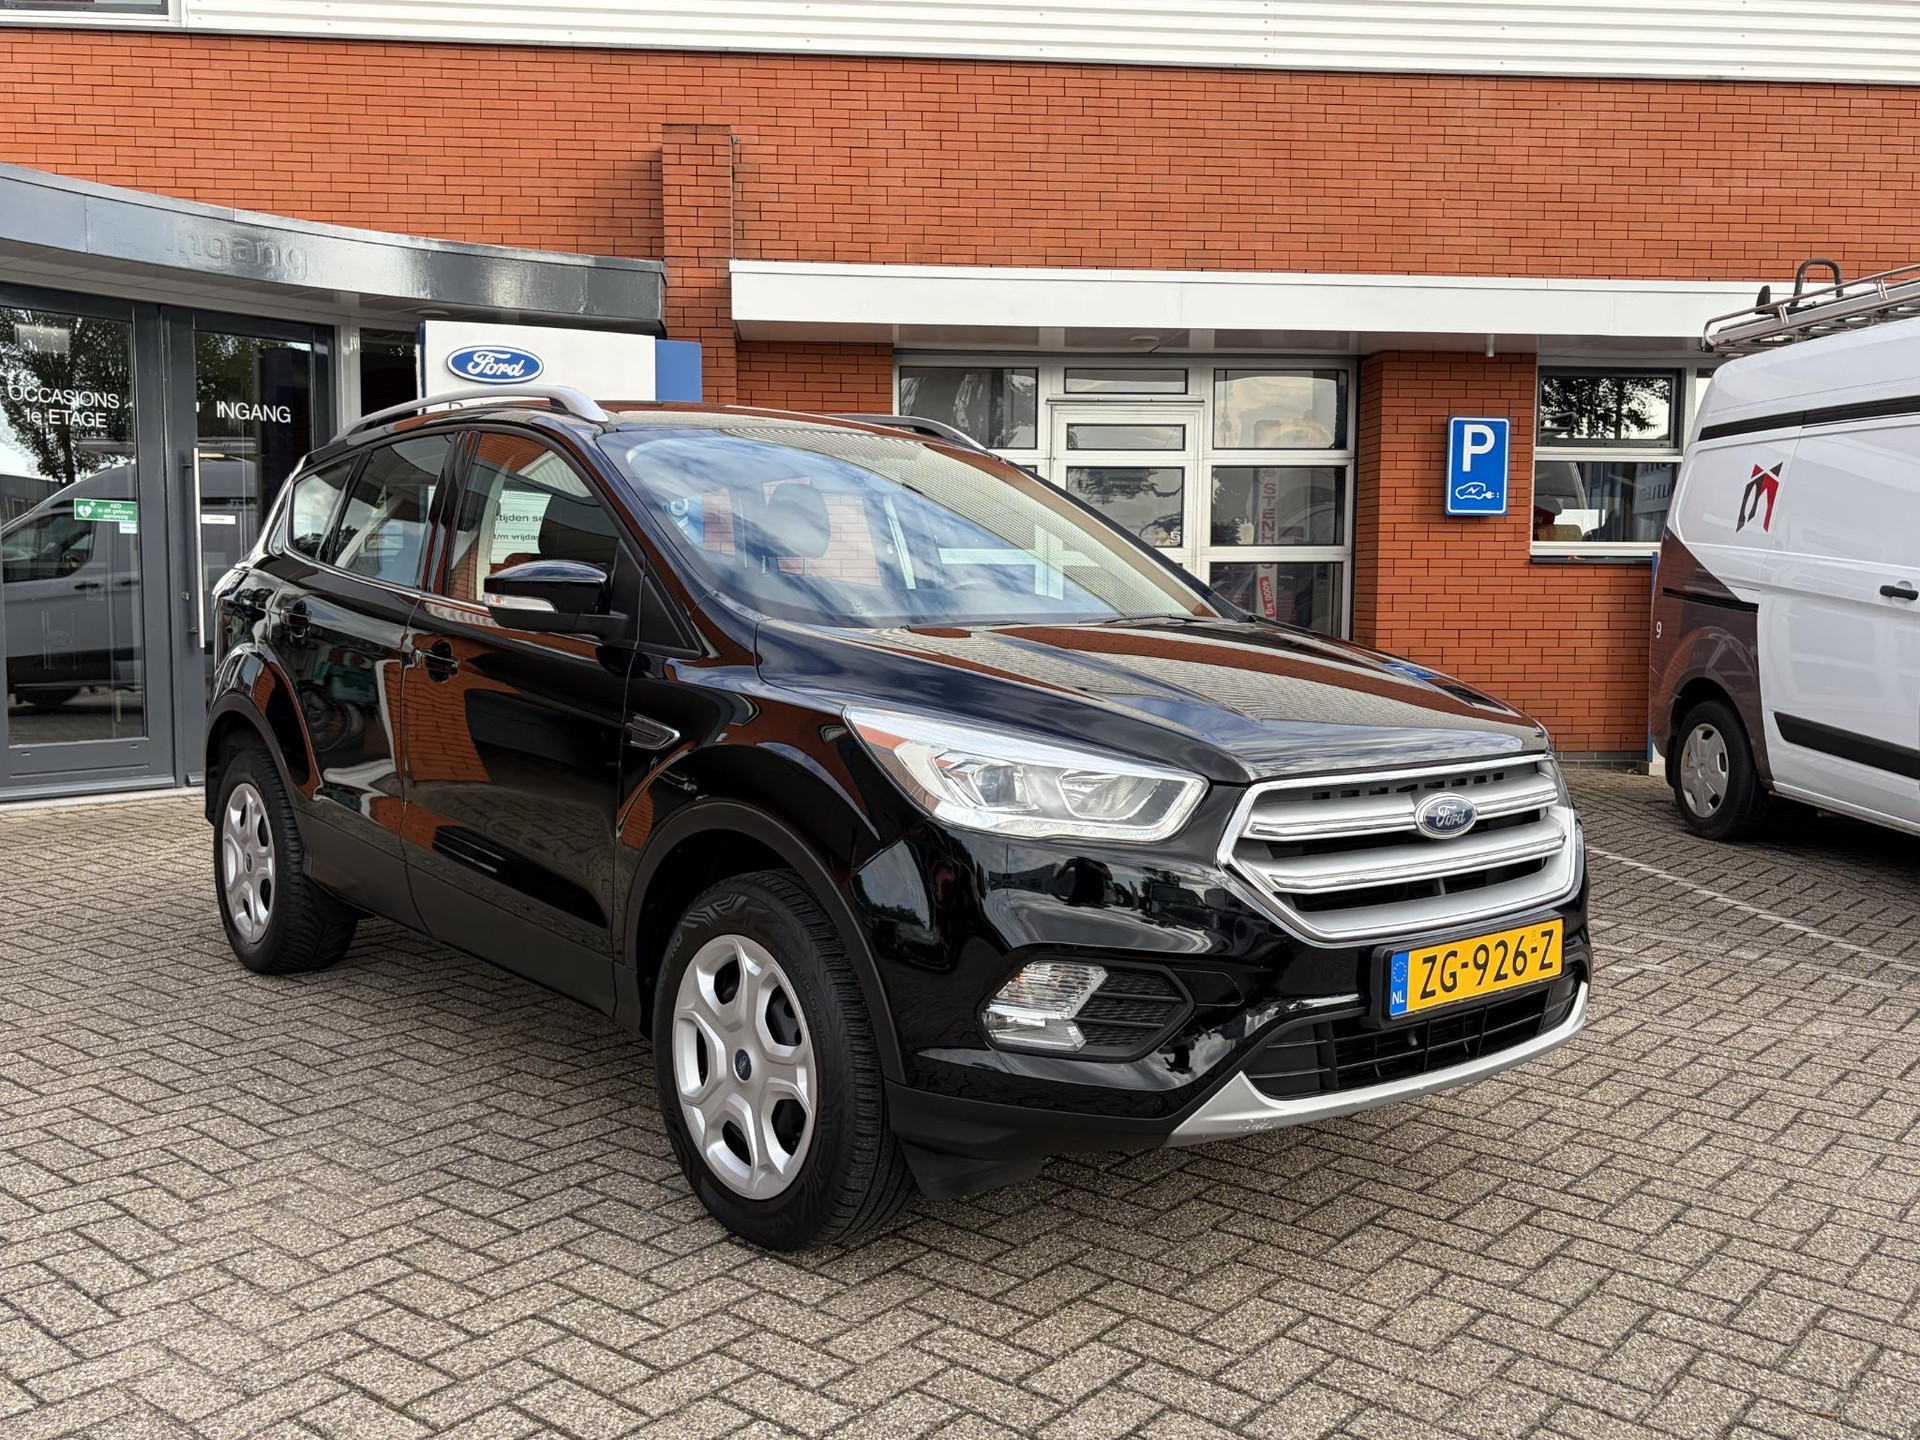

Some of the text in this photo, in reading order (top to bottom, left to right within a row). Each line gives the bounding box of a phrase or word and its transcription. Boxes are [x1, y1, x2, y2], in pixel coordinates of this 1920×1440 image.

[167, 228, 309, 280] ngang
[466, 350, 526, 378] Ford
[8, 385, 120, 409] OCCASIONS
[25, 407, 108, 428] 1e ETAGE
[216, 400, 292, 424] INGANG
[1462, 424, 1495, 472] P
[1656, 620, 1662, 639] 9
[1437, 805, 1466, 827] Ford
[1420, 929, 1555, 1000] ZG-926-Z
[1392, 990, 1405, 1005] NL
